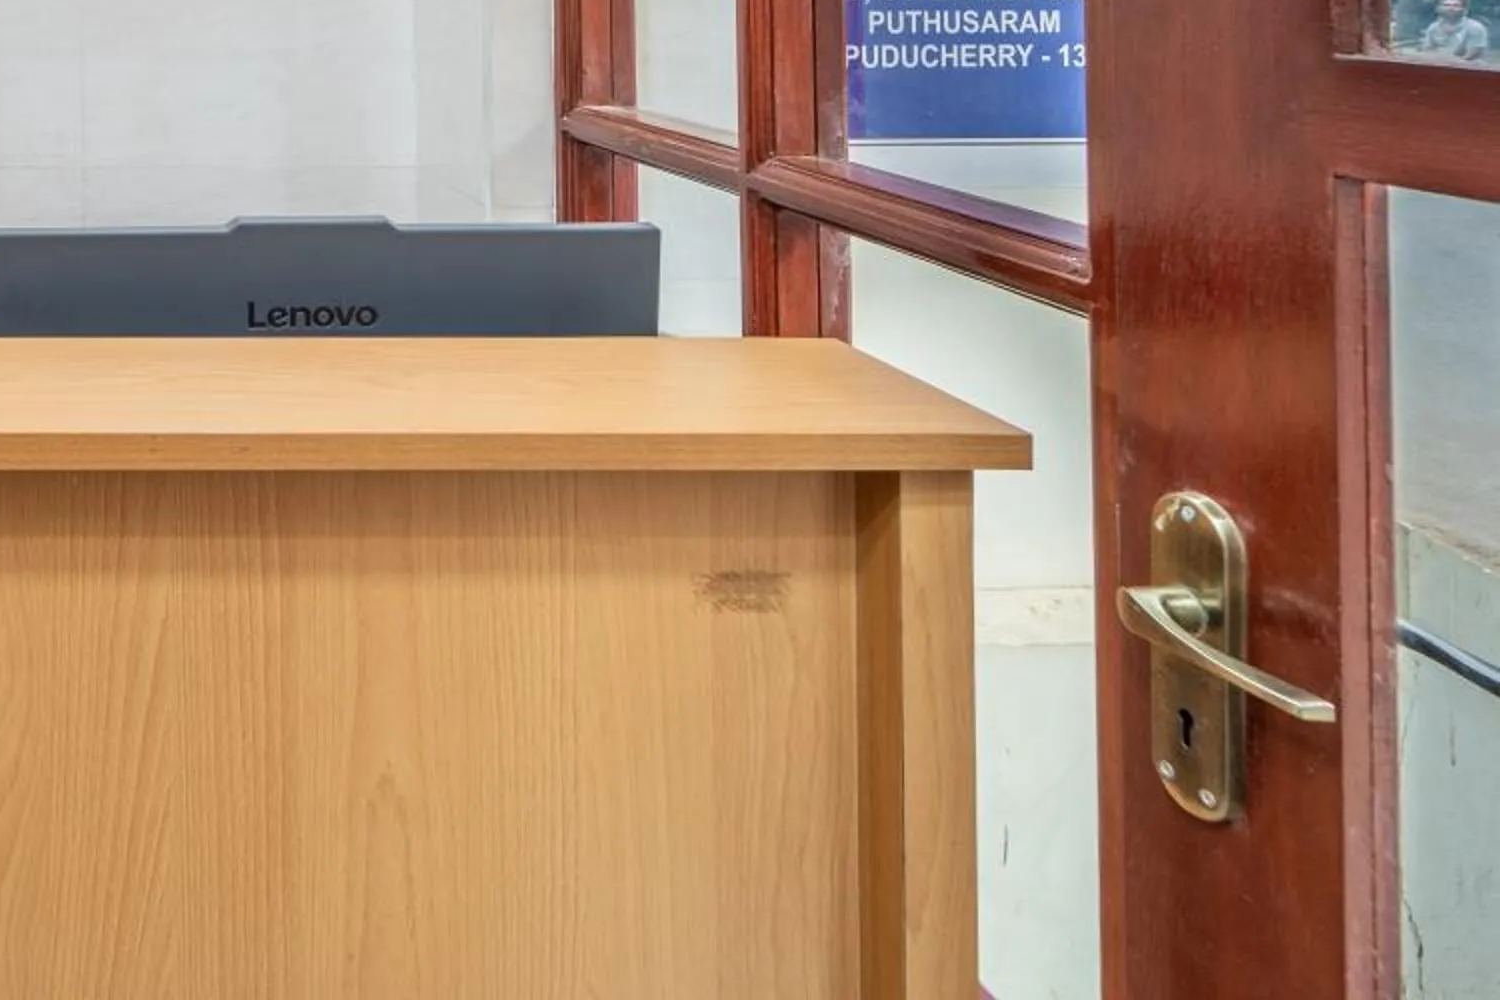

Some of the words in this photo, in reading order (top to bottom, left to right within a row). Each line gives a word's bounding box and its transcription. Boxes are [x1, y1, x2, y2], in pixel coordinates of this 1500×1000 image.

[868, 10, 1061, 34] PUTHUSARAM
[845, 43, 1034, 69] PUDUCHERRY
[1059, 43, 1086, 68] 13
[247, 301, 379, 328] Lenovo
